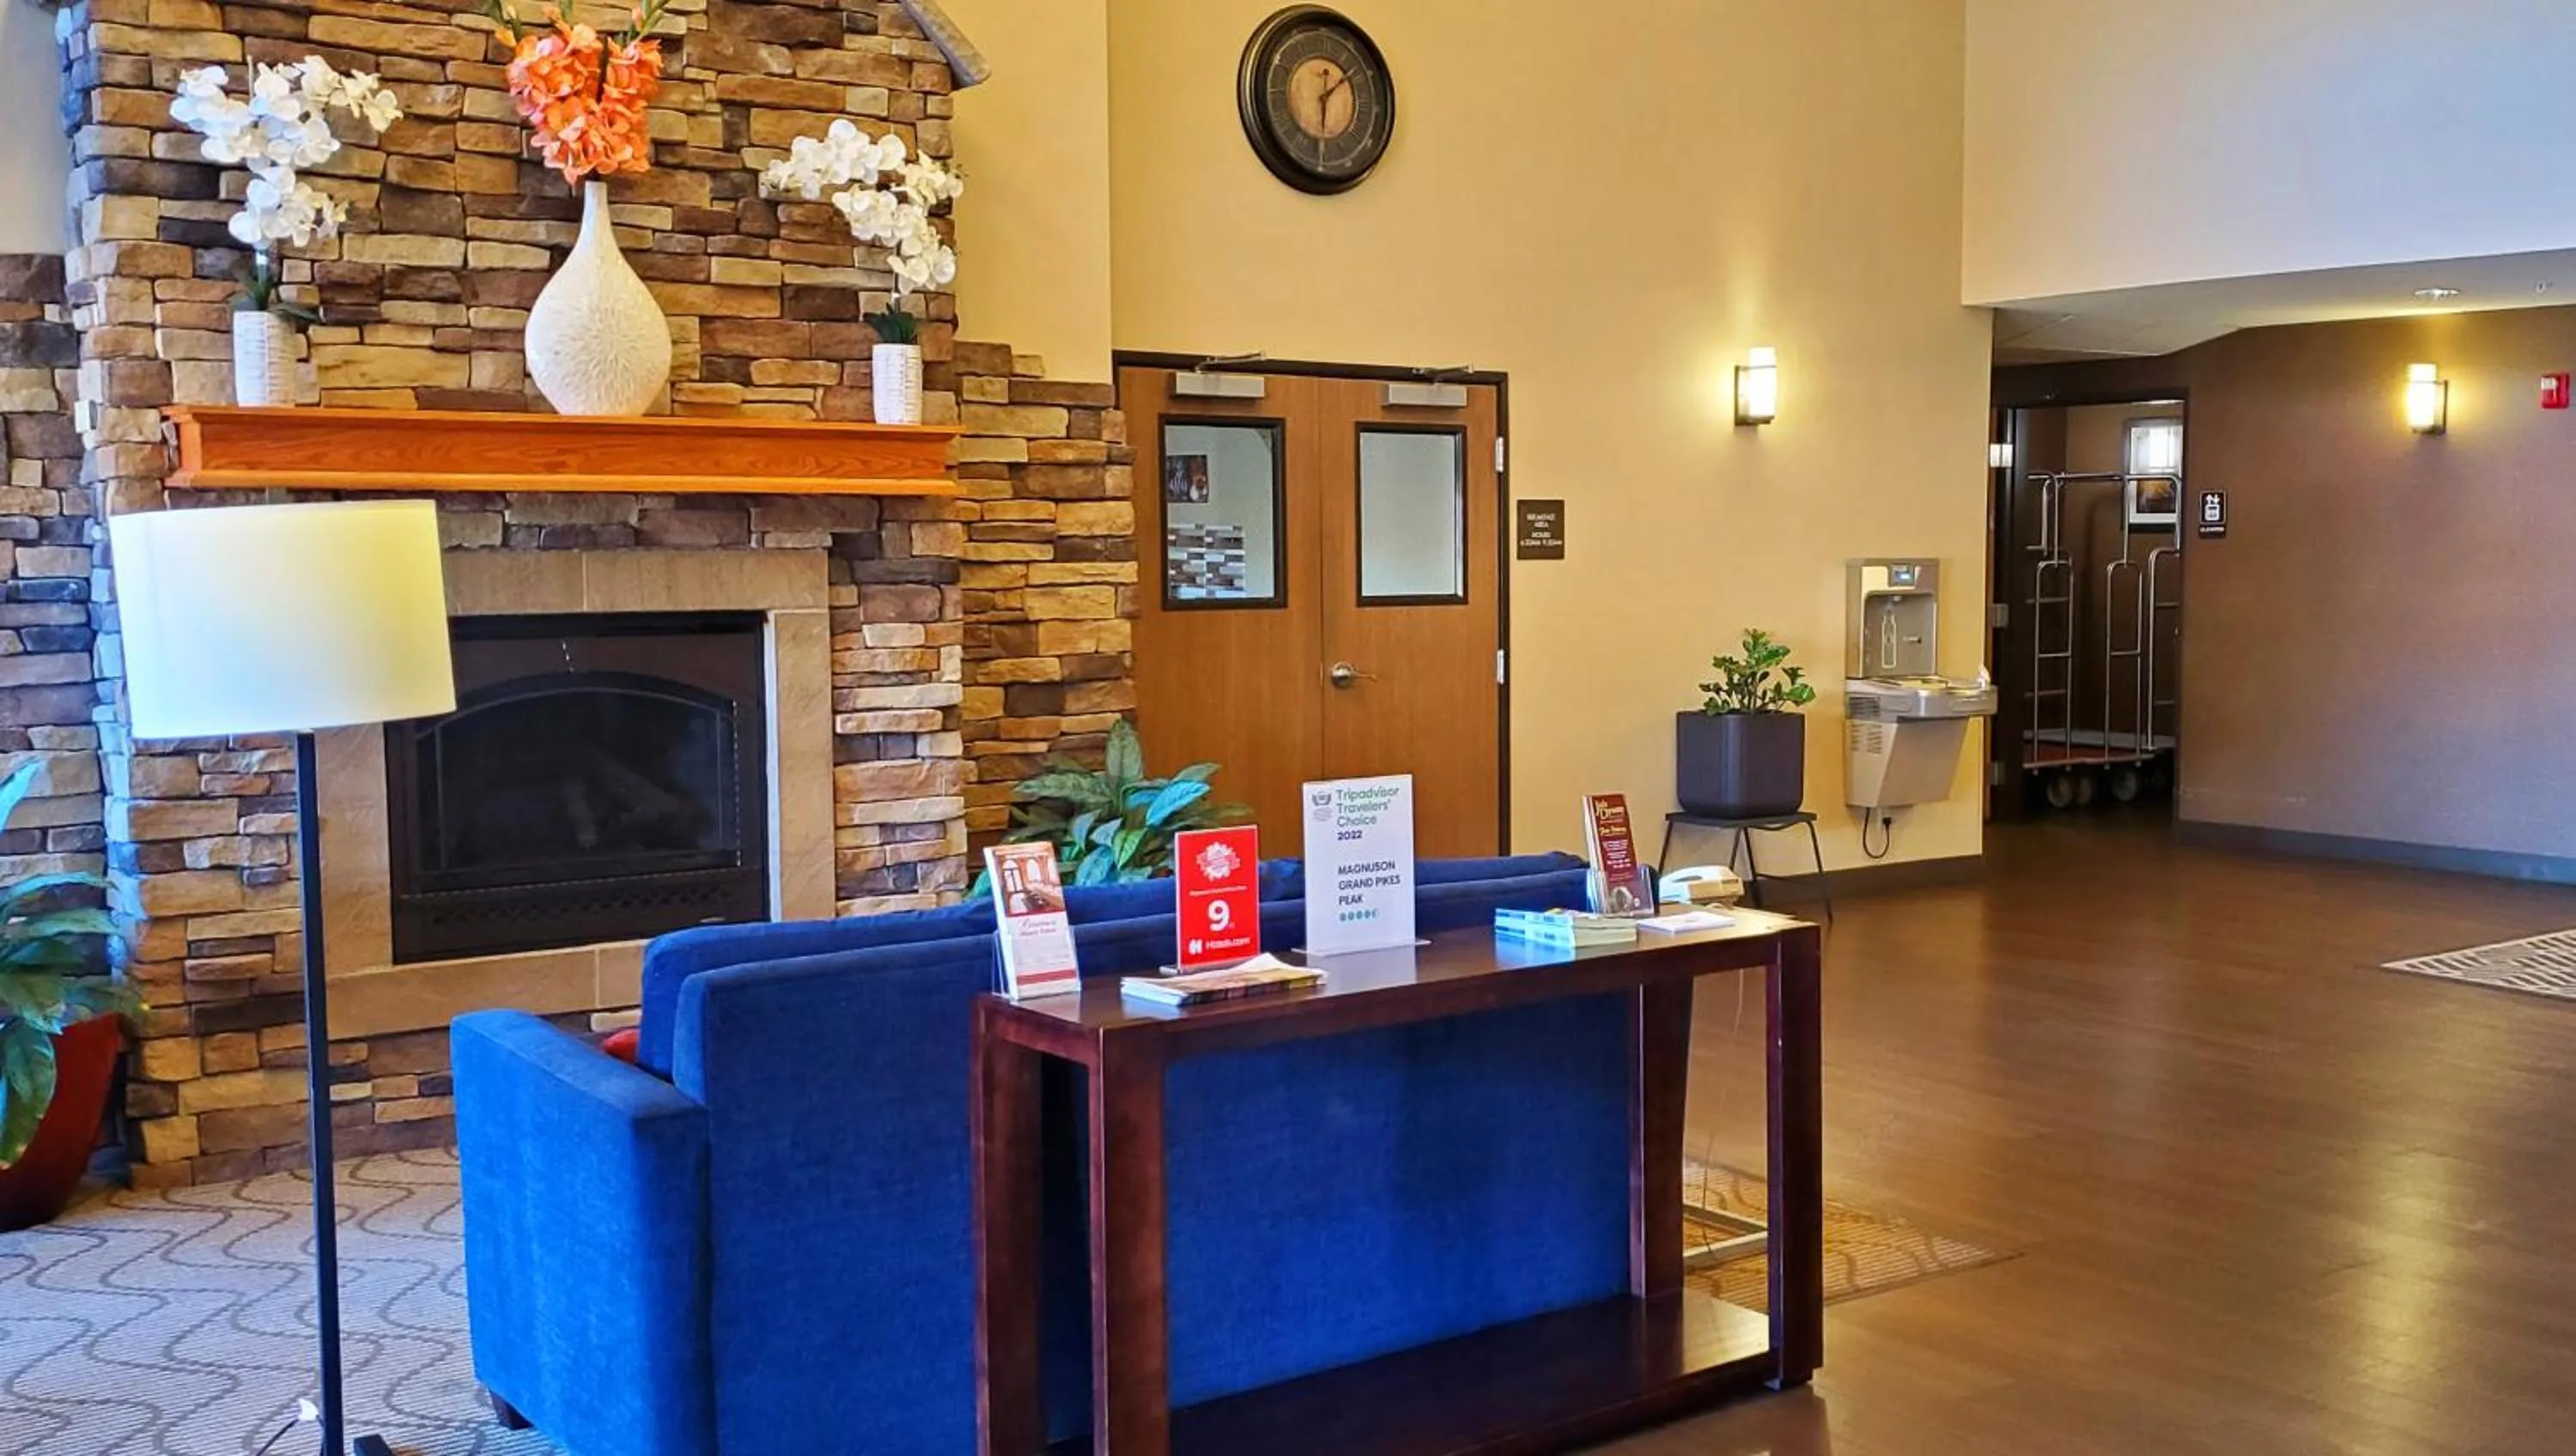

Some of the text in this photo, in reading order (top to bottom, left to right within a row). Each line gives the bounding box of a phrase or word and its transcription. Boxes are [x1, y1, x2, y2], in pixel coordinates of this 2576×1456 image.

[1335, 786, 1400, 803] Tripadvisor
[1337, 813, 1377, 827] Choice
[1337, 830, 1363, 840] 2022
[1338, 860, 1396, 875] MAGNUSON
[1339, 875, 1400, 890] GRAND PIKES
[1339, 895, 1364, 906] PEAK
[1207, 899, 1230, 932] 9
